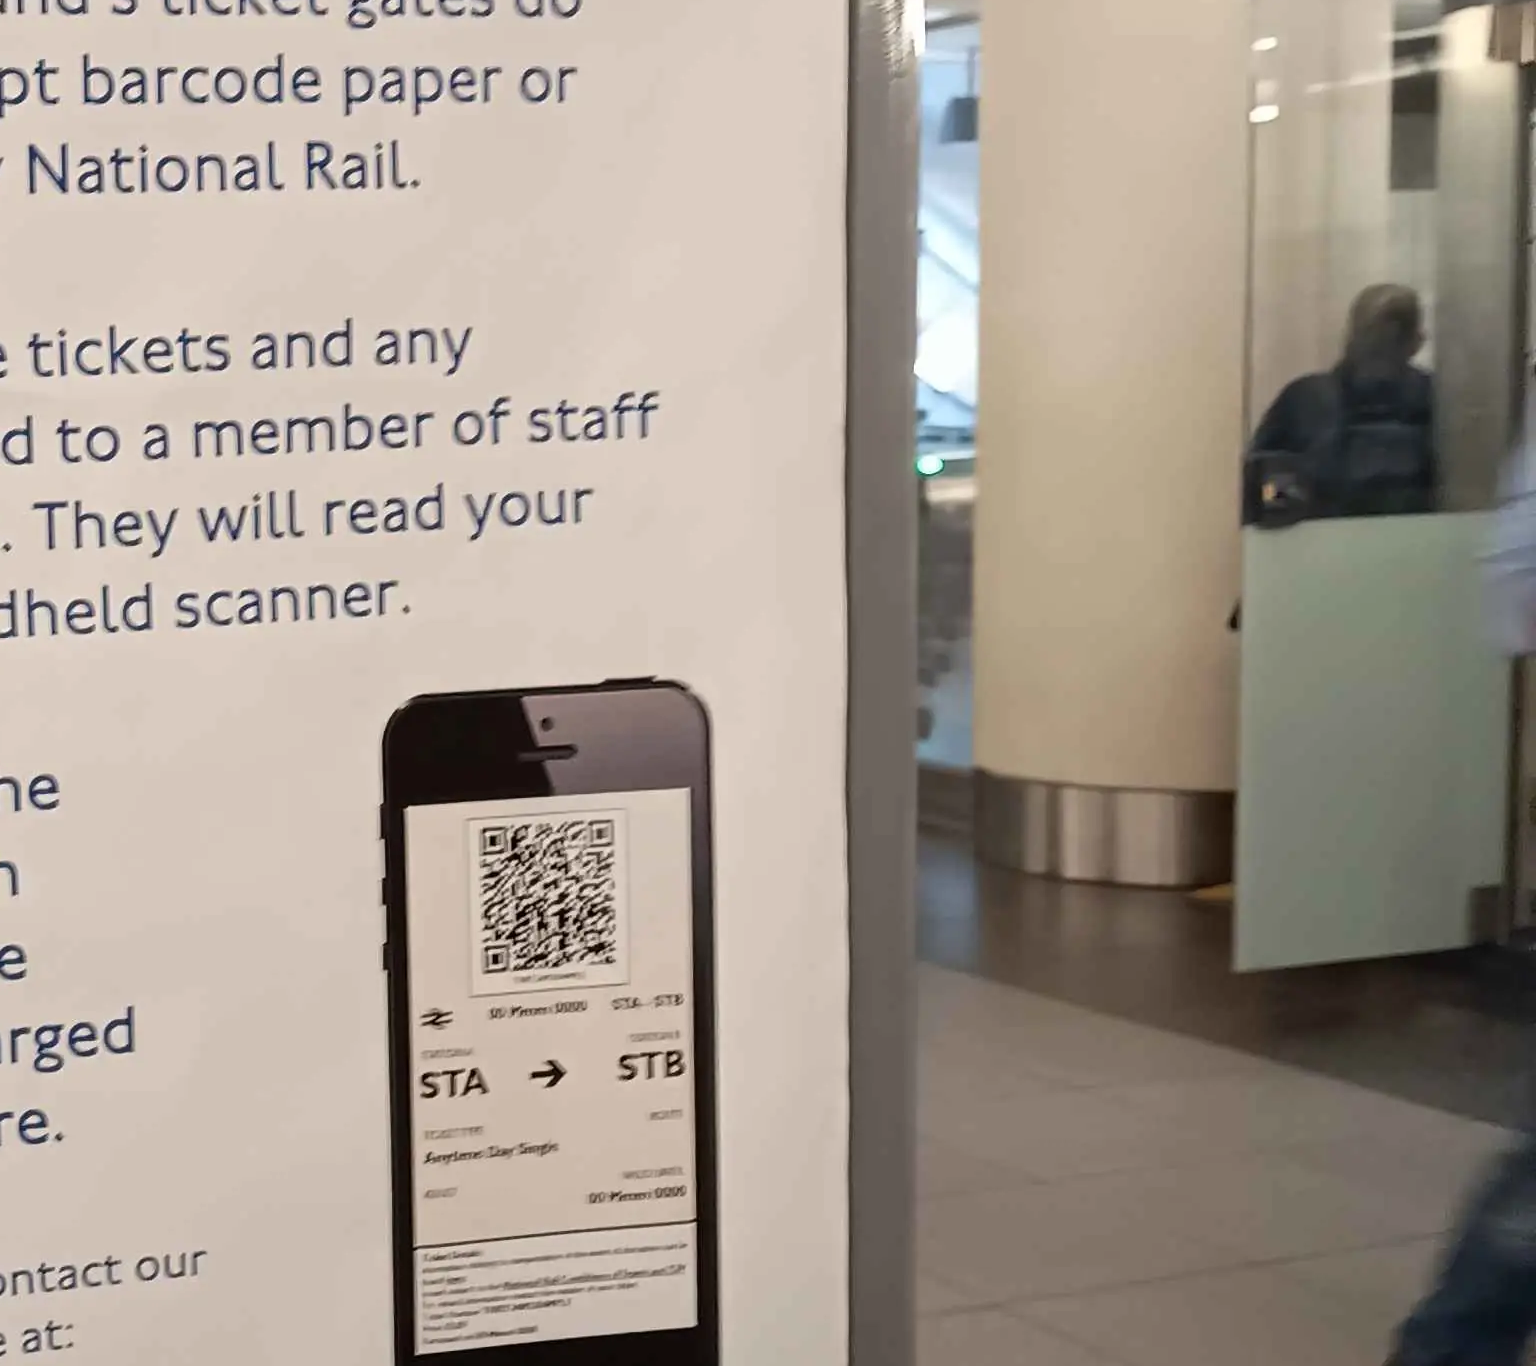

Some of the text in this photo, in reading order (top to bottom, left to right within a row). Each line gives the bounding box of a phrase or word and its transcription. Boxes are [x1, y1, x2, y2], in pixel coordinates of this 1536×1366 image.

[82, 53, 322, 106] barcode
[344, 66, 502, 116] paper
[520, 67, 577, 103] or
[28, 141, 285, 194] National
[304, 140, 421, 190] Rail.
[27, 325, 231, 377] tickets
[250, 318, 353, 370] and
[374, 327, 473, 376] any
[55, 419, 120, 463] to
[142, 424, 170, 461] a
[194, 403, 434, 458] member
[453, 396, 510, 445] of
[528, 391, 659, 443] staff
[32, 500, 179, 558] They
[197, 490, 305, 542] will
[325, 483, 444, 536] read
[464, 488, 595, 542] your
[174, 580, 410, 629] scanner.
[420, 1067, 489, 1099] STA
[616, 1049, 686, 1082] STB
[135, 1250, 207, 1281] our
[21, 1320, 74, 1354] at:
